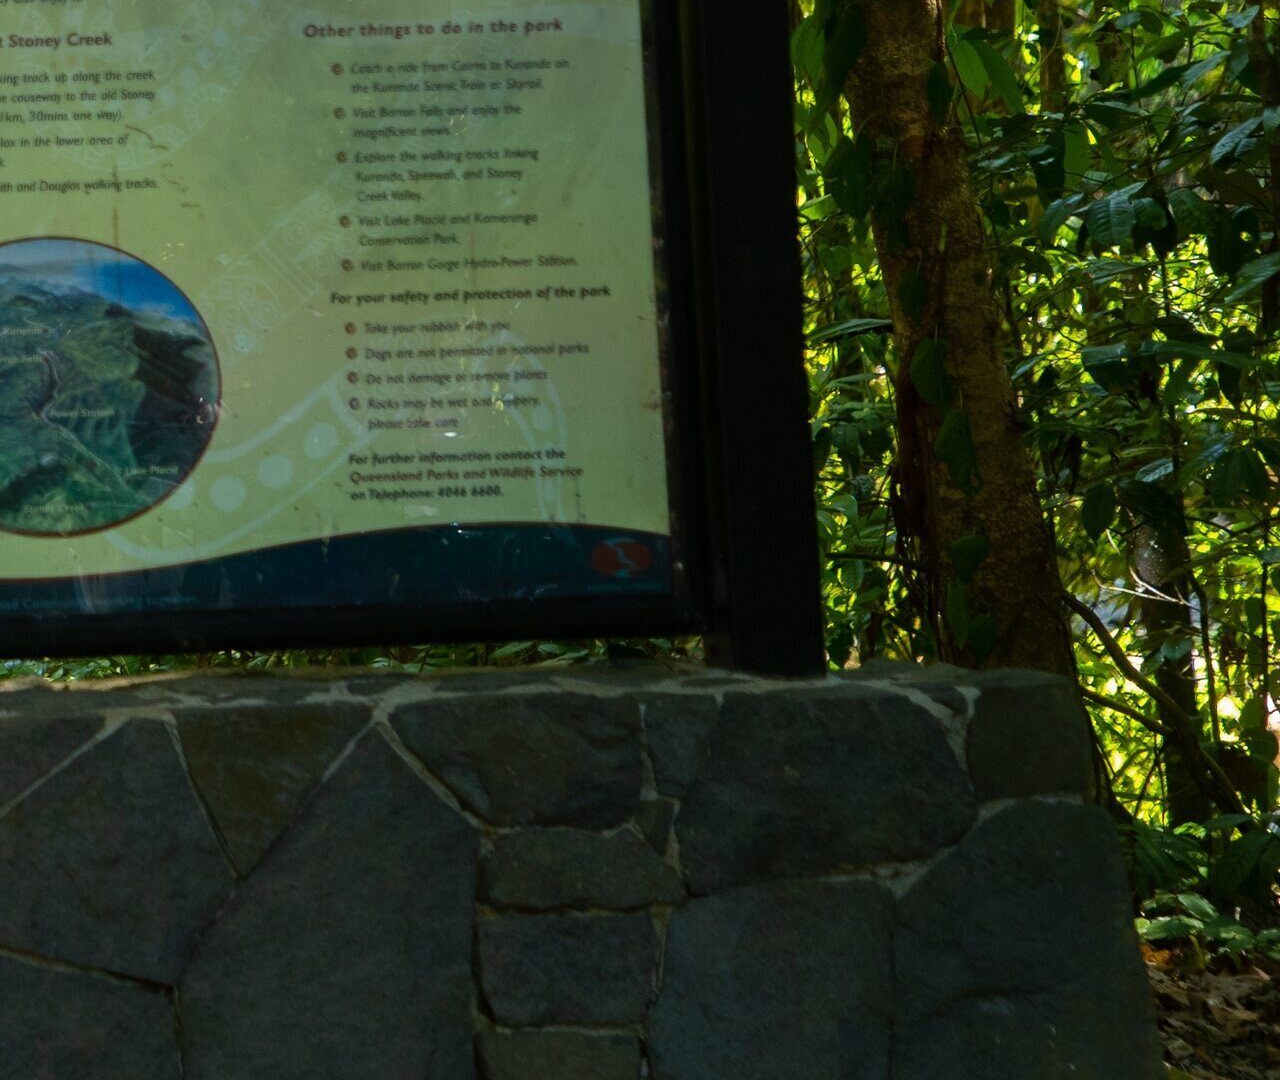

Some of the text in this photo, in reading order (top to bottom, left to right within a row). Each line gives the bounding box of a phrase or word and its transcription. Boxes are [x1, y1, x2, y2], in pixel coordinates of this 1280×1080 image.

[303, 18, 564, 41] Other things to do in the park
[8, 33, 62, 52] Stoney
[66, 32, 113, 46] Creek
[22, 72, 50, 83] track
[54, 75, 69, 86] up
[72, 71, 101, 85] along
[105, 70, 123, 81] the
[125, 69, 155, 81] creek
[11, 95, 62, 106] causeway
[65, 92, 77, 102] to
[79, 90, 98, 101] the
[101, 90, 118, 101] old
[120, 89, 157, 103] Stoney
[28, 111, 69, 122] 30mins
[73, 113, 93, 121] one
[96, 109, 125, 124] way).
[19, 136, 31, 147] in
[33, 136, 52, 147] the
[55, 135, 85, 146] lower
[88, 137, 114, 145] area
[117, 134, 130, 147] of
[353, 125, 418, 140] magnificent
[355, 148, 540, 165] Explore the walking tracks linking
[16, 180, 37, 191] and
[39, 179, 81, 194] Douglas
[83, 178, 123, 193] walking
[329, 284, 611, 308] For your safety and protection of the park
[348, 448, 567, 467] For further information contact the
[349, 465, 584, 482] Queensland Parks and Wildlife Service
